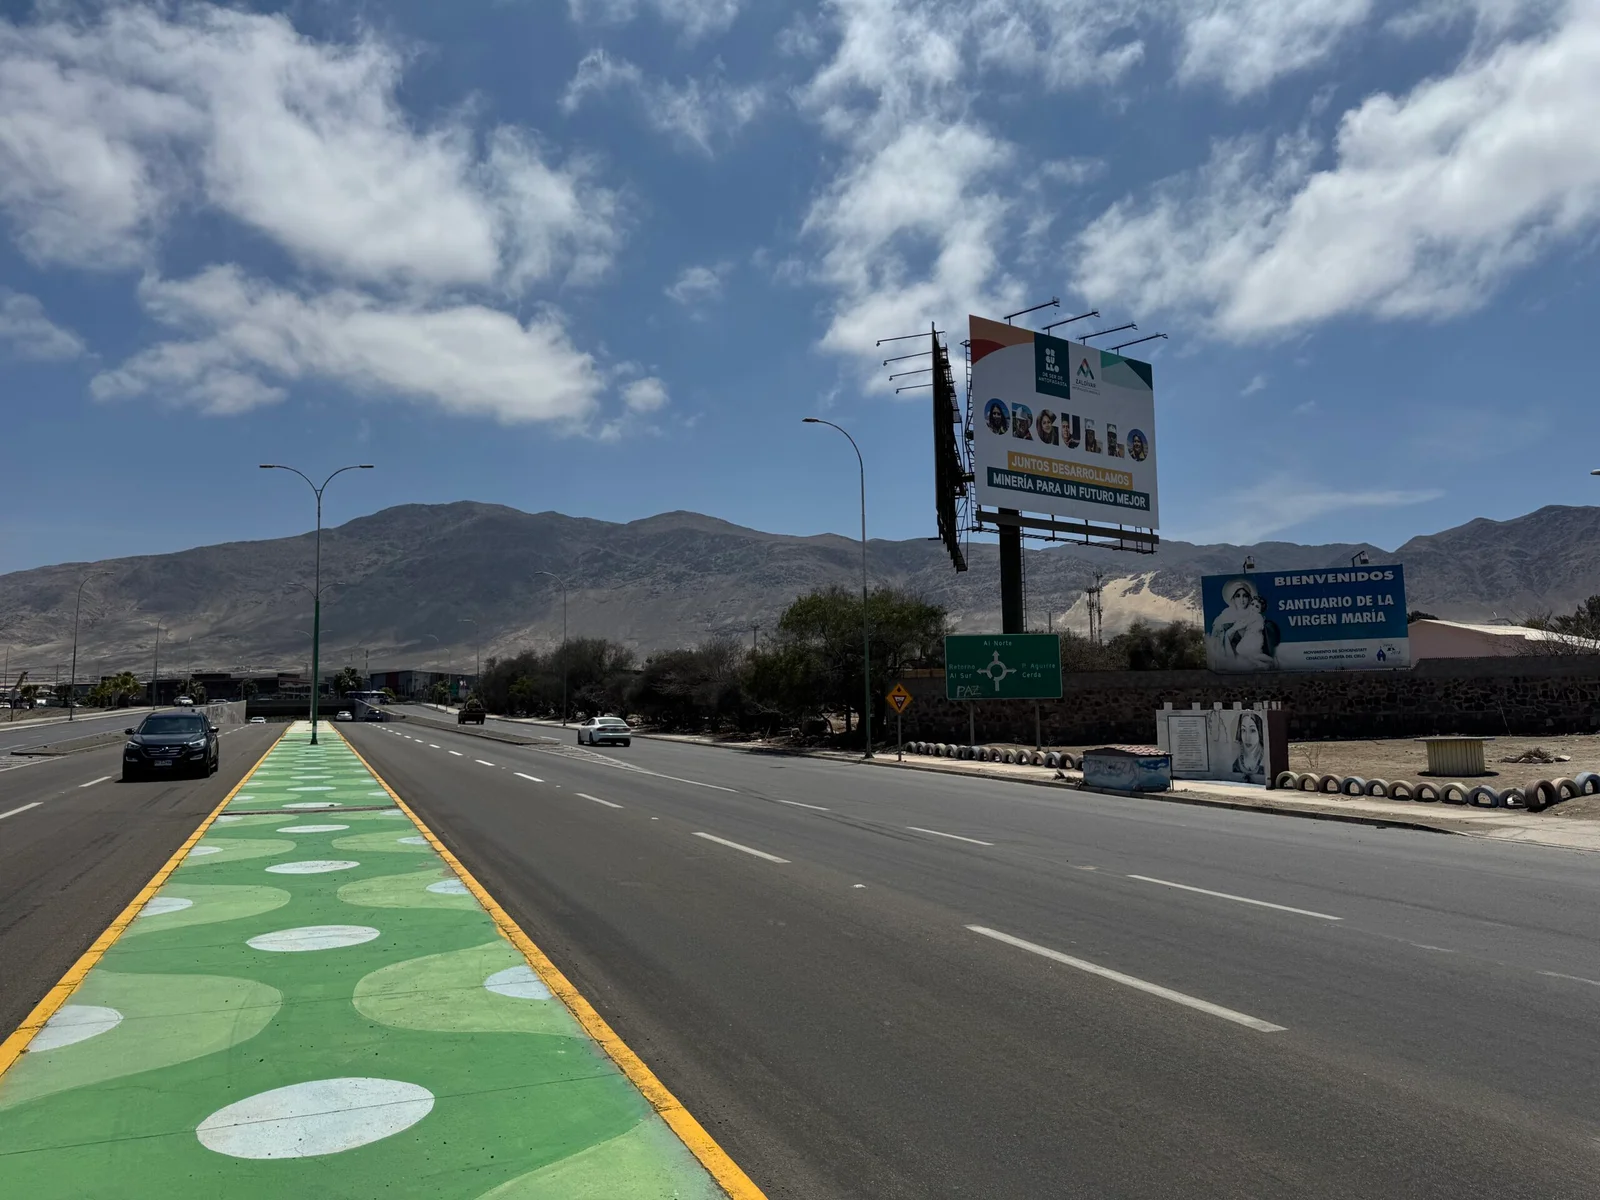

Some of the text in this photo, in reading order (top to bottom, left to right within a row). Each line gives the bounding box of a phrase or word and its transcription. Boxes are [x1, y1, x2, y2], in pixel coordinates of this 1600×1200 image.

[984, 398, 1148, 462] ORGULLO
[1011, 455, 1129, 486] JUNTOS DESARROLLAMOS
[993, 472, 1146, 508] MINERÍA PARA UN FUTURO MEJOR
[1274, 570, 1394, 586] BIENVENIDOS
[1278, 594, 1394, 611] SANTUARIO DE LA
[1288, 608, 1386, 627] VIRGEN MARÍA
[1030, 662, 1056, 670] Aguirre
[956, 685, 982, 698] PAZ
